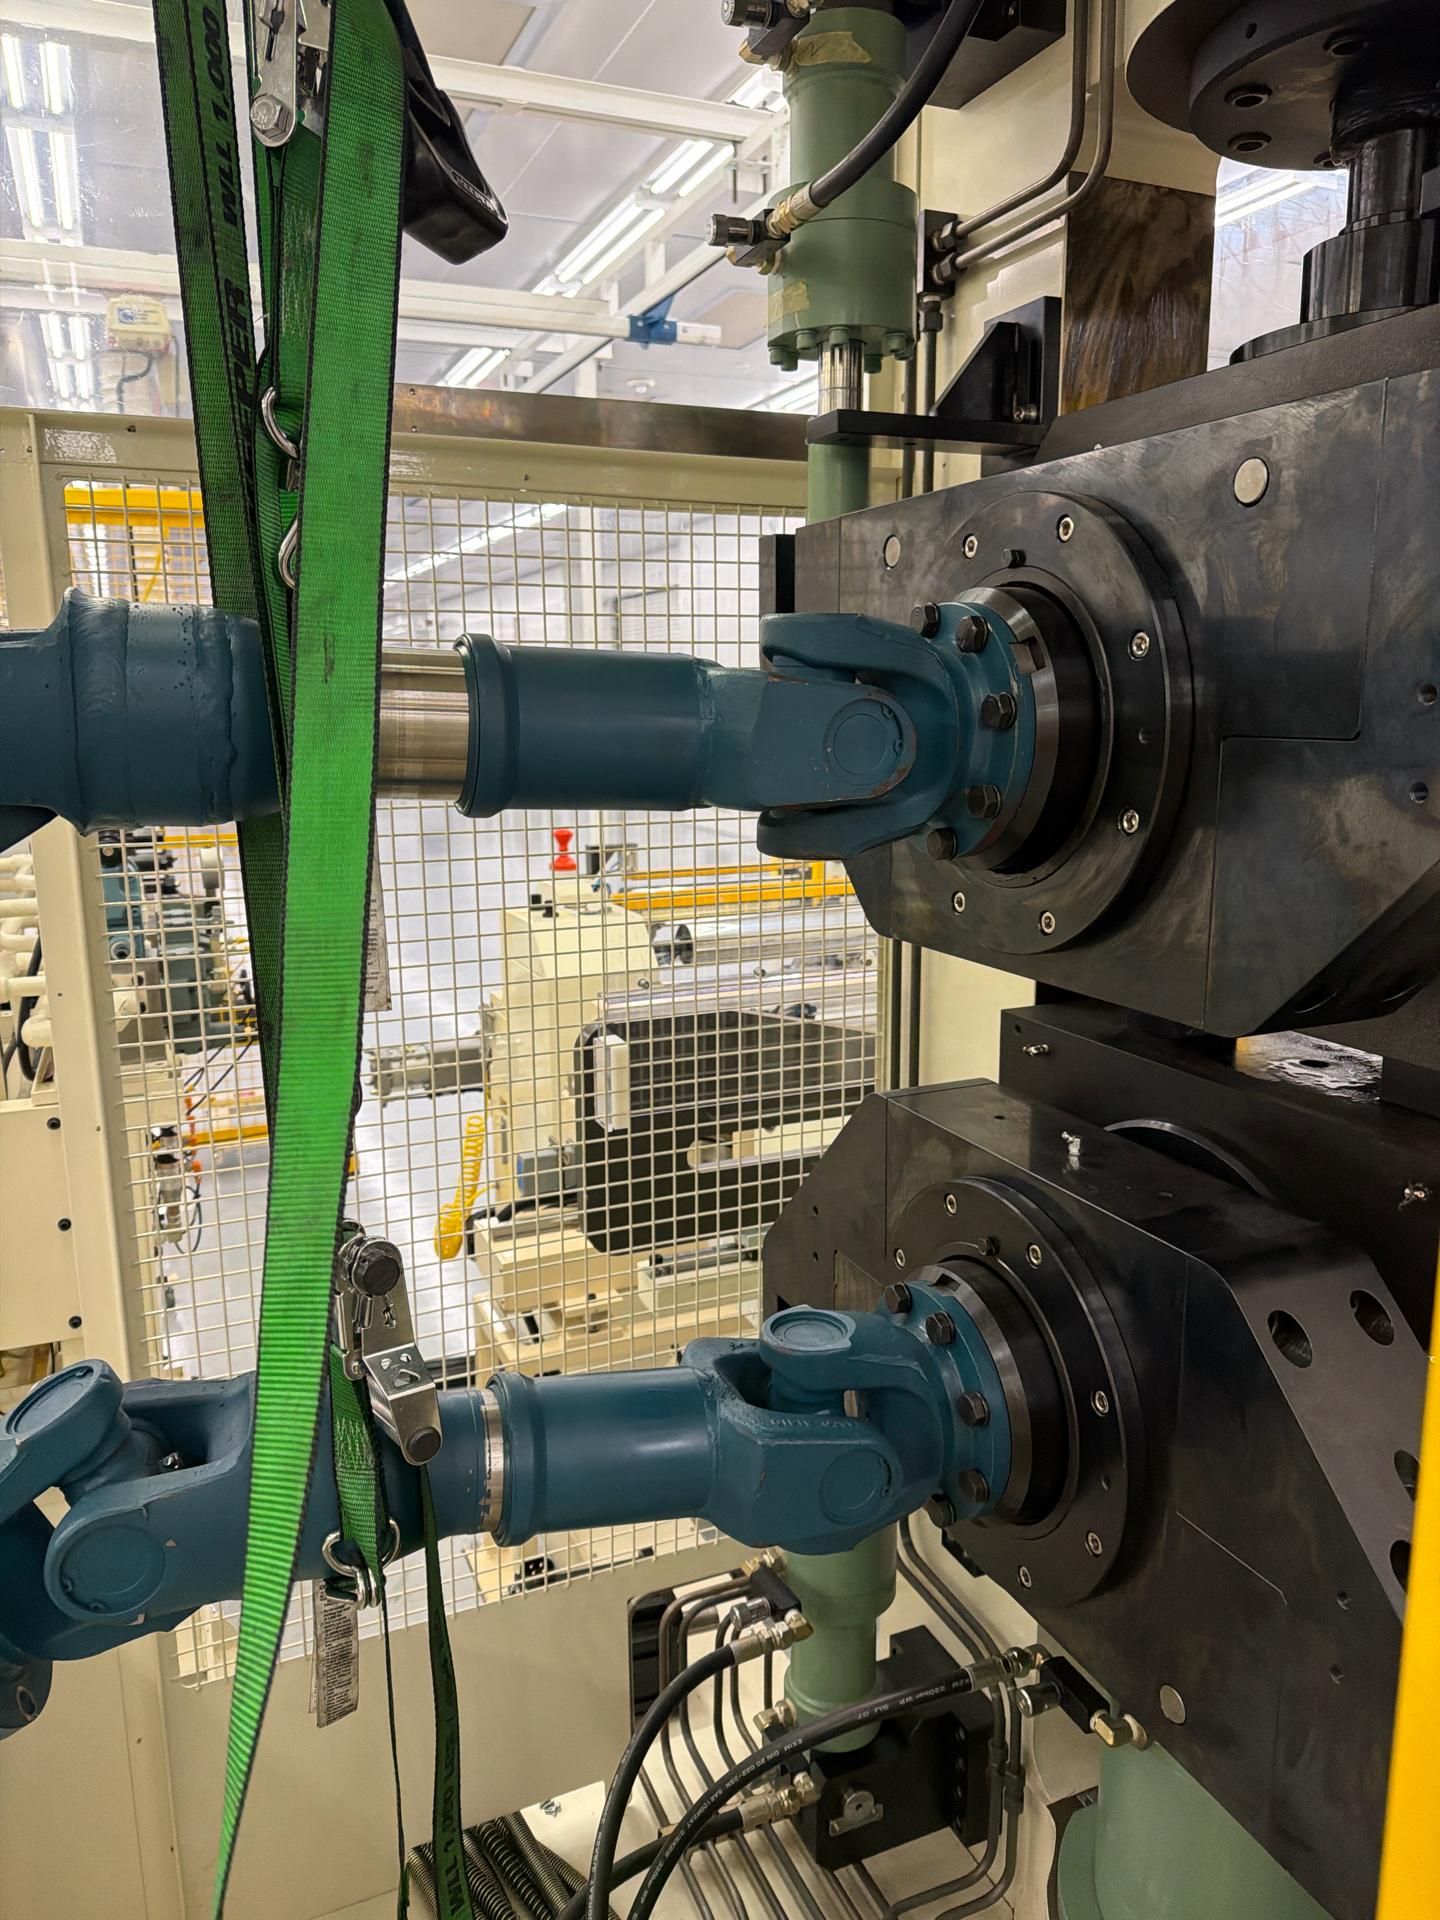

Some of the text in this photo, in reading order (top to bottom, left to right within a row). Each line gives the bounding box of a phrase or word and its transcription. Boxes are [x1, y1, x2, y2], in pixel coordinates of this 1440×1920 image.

[202, 6, 229, 126] 1,000
[214, 140, 237, 227] WLL
[900, 1695, 914, 1706] WP
[766, 1749, 781, 1761] DIN
